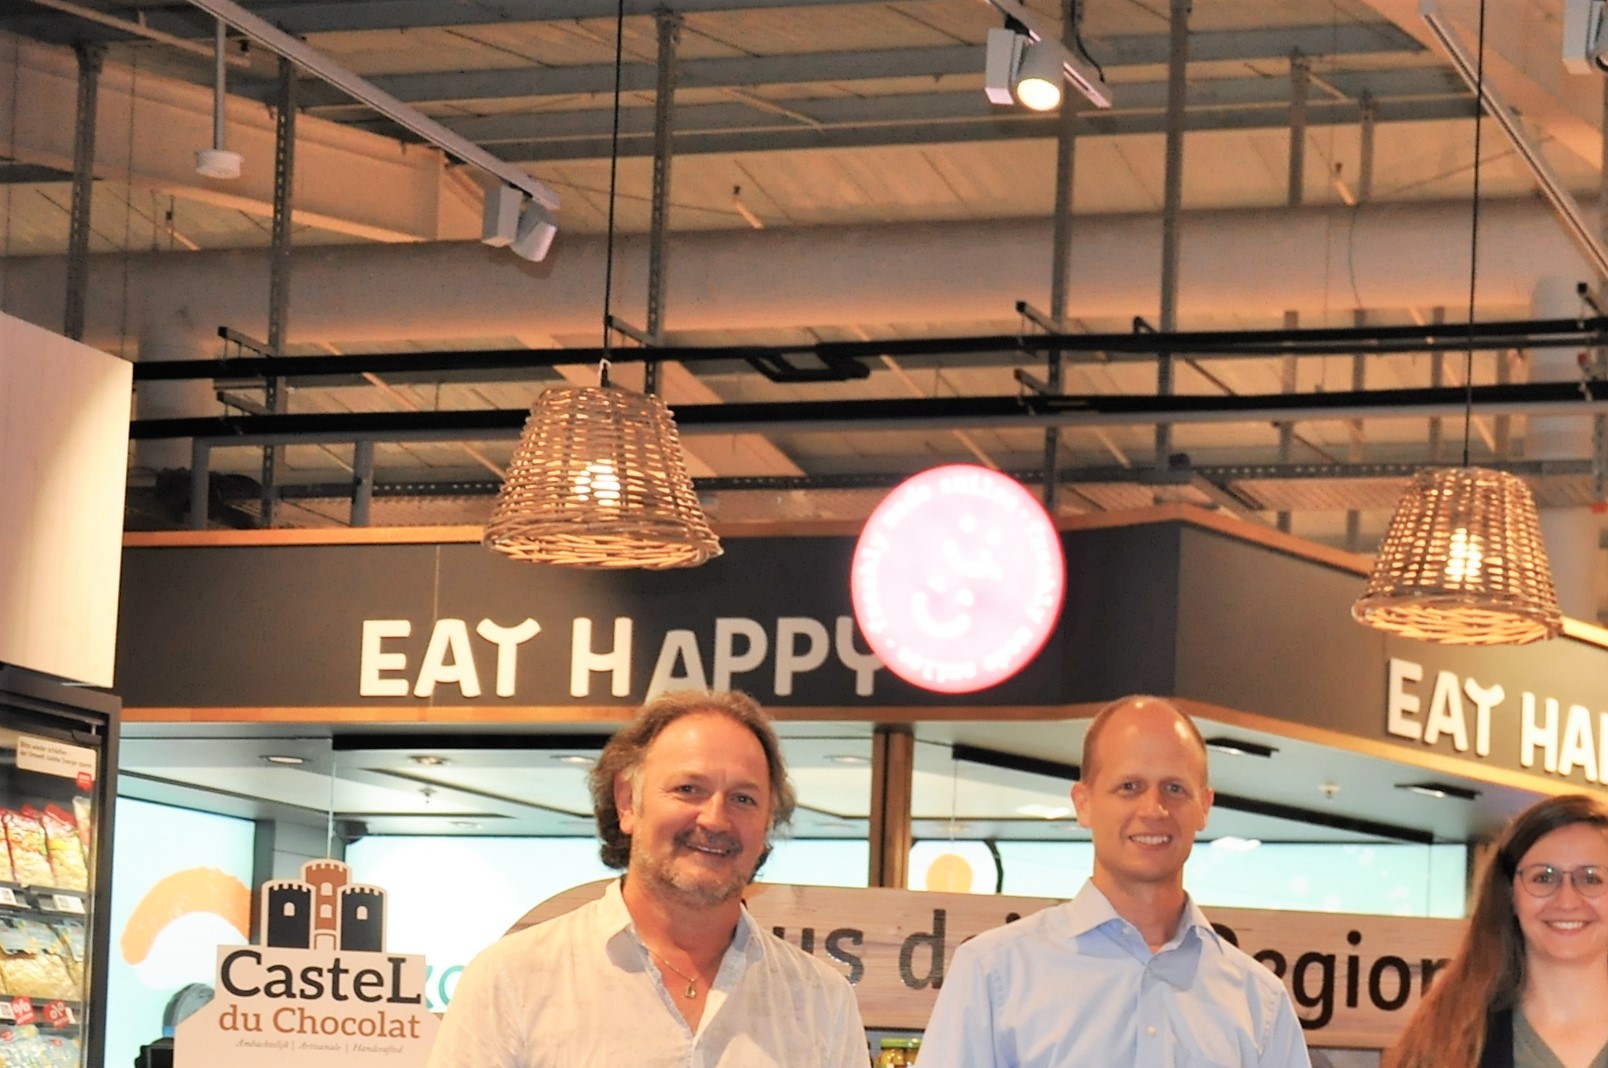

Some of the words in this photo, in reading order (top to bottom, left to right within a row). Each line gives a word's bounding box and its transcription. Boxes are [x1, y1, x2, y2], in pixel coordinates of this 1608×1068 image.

[359, 616, 541, 699] EAT
[569, 616, 886, 699] HAPPY
[1387, 657, 1506, 757] EAT
[220, 949, 422, 1005] CasteL
[218, 1004, 263, 1033] du
[272, 1006, 421, 1039] Chocolat
